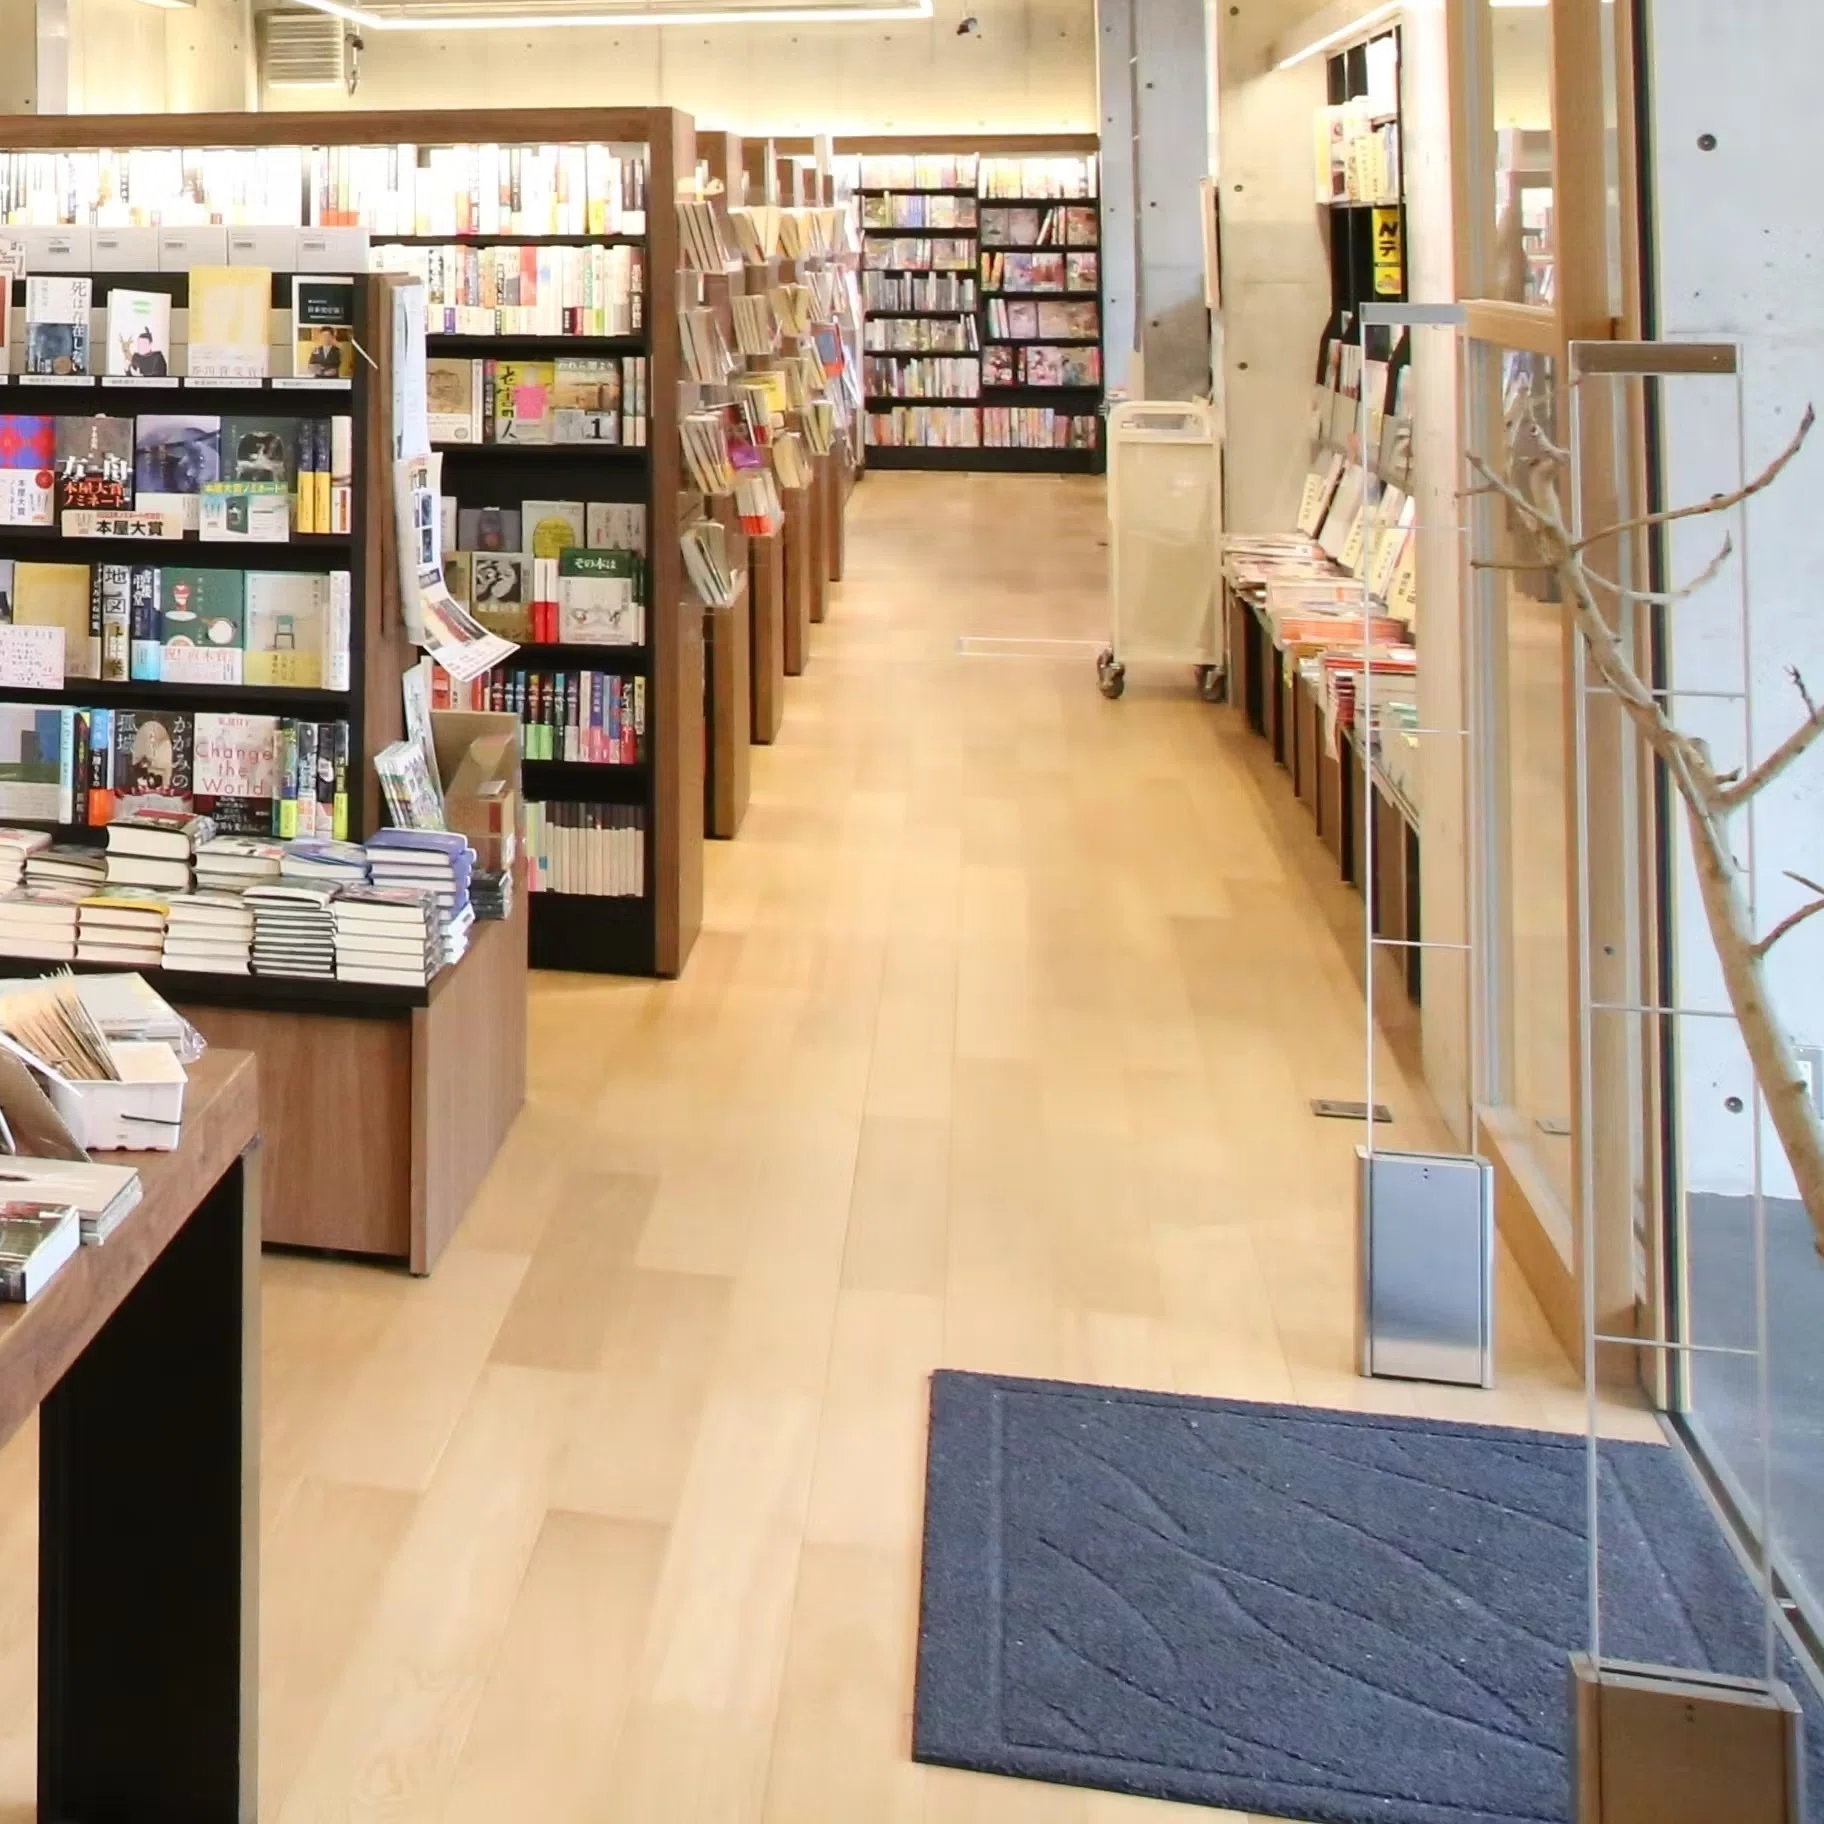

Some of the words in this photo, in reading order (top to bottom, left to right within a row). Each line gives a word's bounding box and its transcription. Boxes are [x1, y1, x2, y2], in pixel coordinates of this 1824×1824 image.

[96, 520, 164, 537] 本屋大賞
[574, 557, 617, 570] その本は
[172, 715, 193, 789] かがみの
[195, 741, 274, 764] Change
[217, 764, 249, 778] the
[202, 777, 265, 795] World
